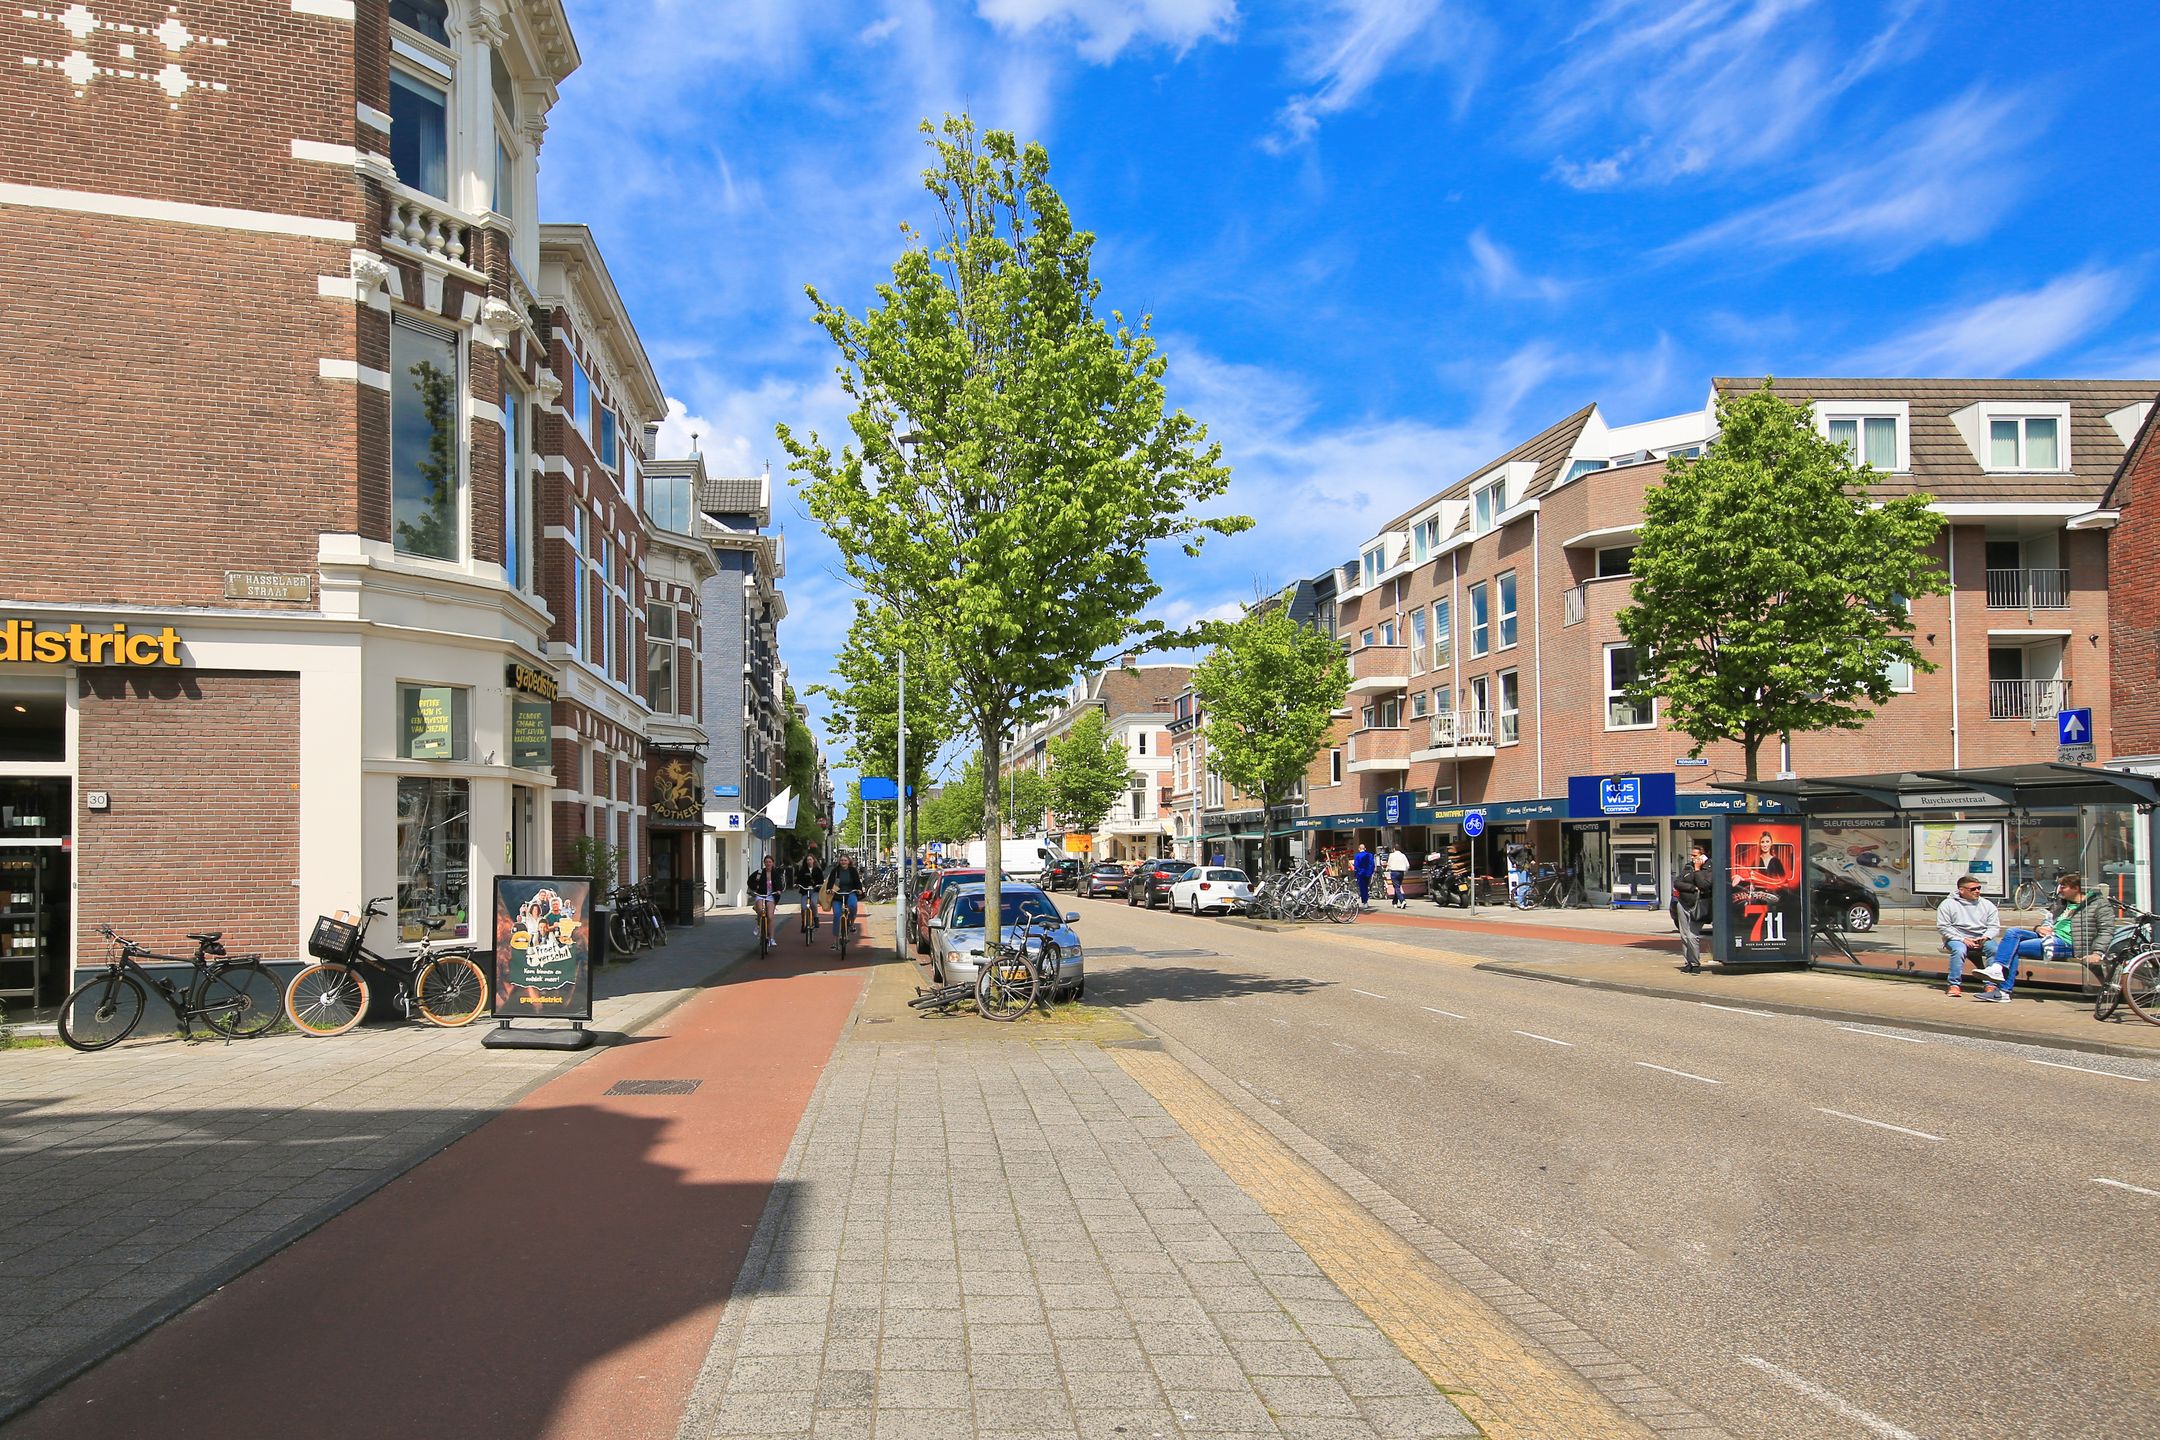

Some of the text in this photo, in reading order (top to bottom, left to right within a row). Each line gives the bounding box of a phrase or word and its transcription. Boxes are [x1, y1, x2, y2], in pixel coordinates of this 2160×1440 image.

[246, 575, 306, 586] HASSELAER
[248, 586, 288, 597] STRAAT
[1605, 783, 1634, 793] KLUS
[89, 795, 105, 805] 30
[1920, 796, 1986, 806] Ruychaverstraat
[651, 801, 704, 820] APOTHEEK
[1679, 820, 1711, 828] KASTEN
[1823, 819, 1885, 827] SLEUTELSERVICE
[537, 948, 570, 963] verschil
[519, 996, 563, 1004] grapedistrict
